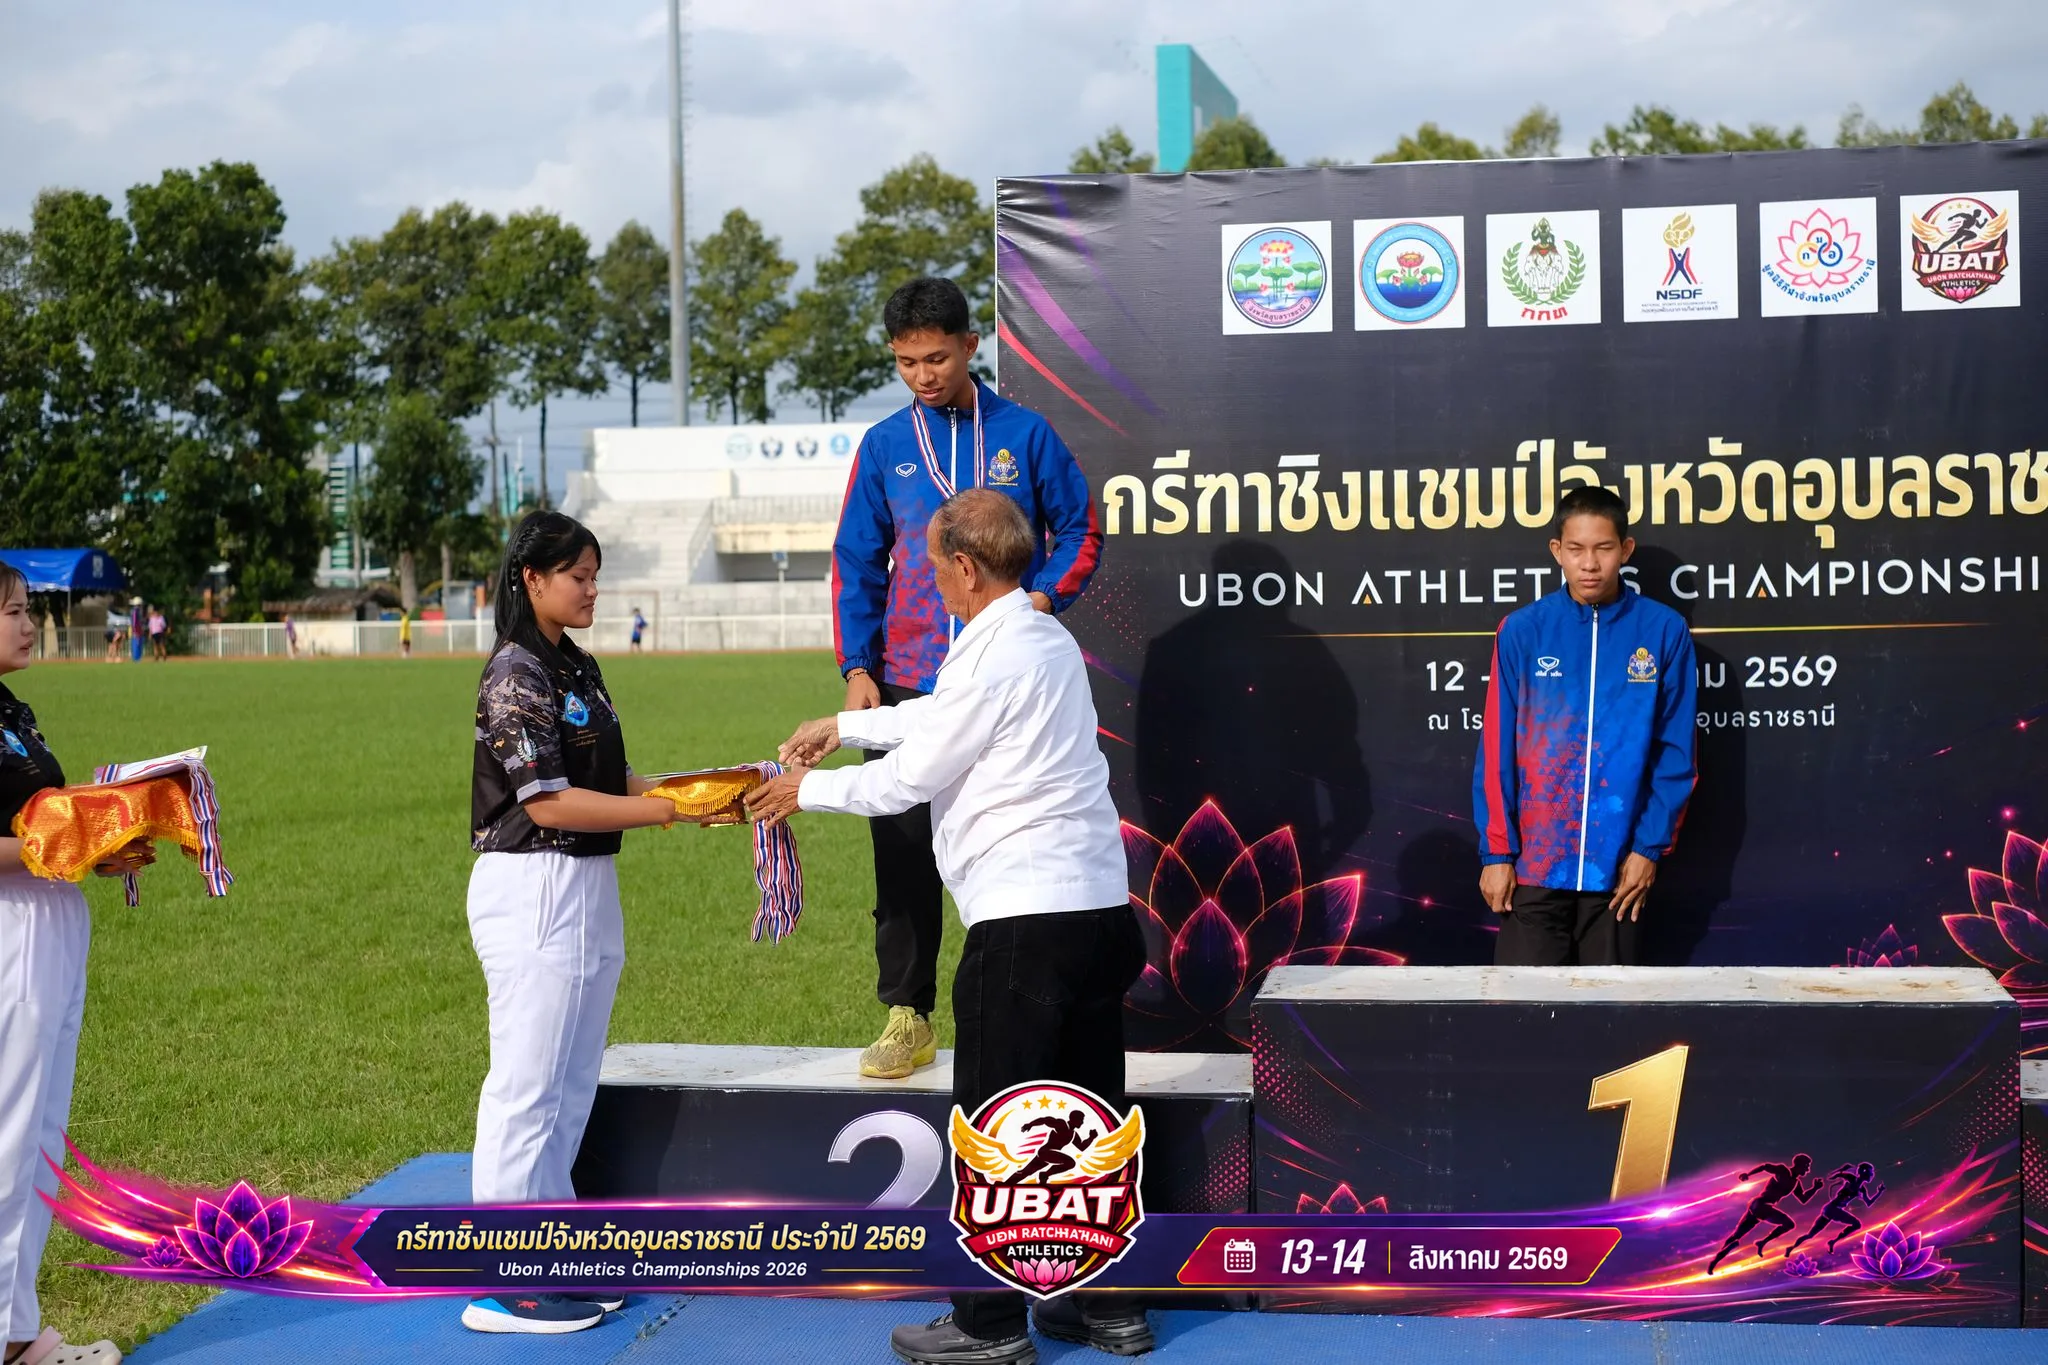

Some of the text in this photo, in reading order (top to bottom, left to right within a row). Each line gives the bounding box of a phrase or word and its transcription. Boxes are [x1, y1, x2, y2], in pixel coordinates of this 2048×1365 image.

[1920, 251, 2001, 274] UBAT
[1927, 272, 1997, 284] UBON RATCHATHANI
[1941, 280, 1981, 288] ATHLETICS
[1656, 288, 1703, 300] NSDF
[1520, 306, 1568, 321] กกท
[1179, 572, 1324, 607] UBON
[1426, 660, 1465, 691] 12
[1745, 654, 1838, 688] 2569
[1428, 714, 1449, 730] ณ
[1588, 1044, 1690, 1203] 1
[828, 1110, 944, 1209] 2
